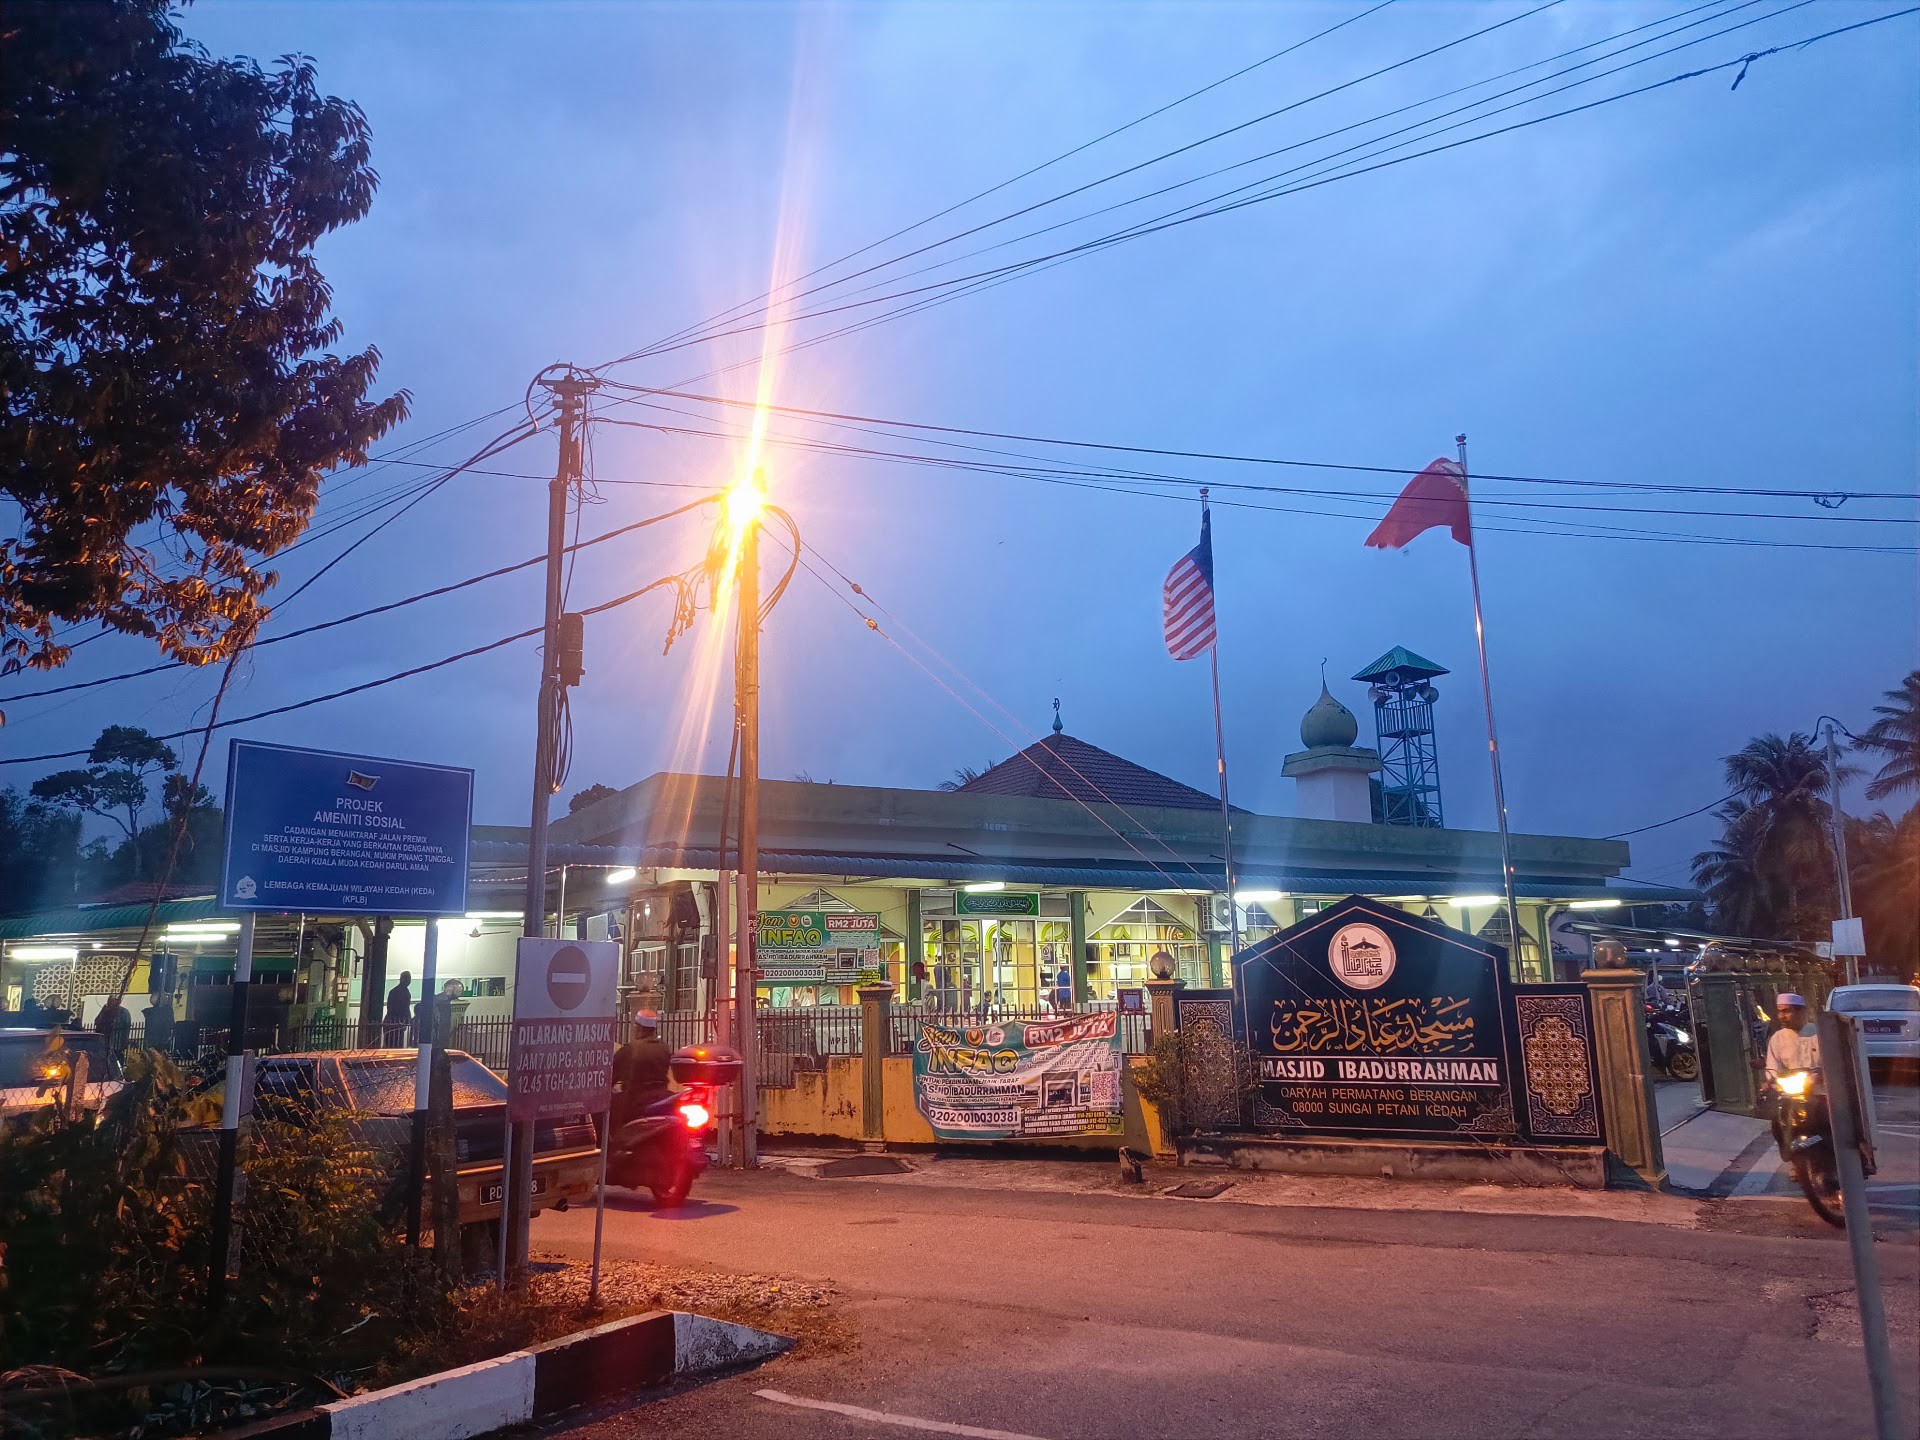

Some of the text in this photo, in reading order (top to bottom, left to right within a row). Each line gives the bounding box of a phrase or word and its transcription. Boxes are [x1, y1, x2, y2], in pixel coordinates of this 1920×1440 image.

[336, 797, 383, 813] PROJEK
[314, 811, 406, 829] AMENITI SOSIAL
[284, 825, 327, 836] CADANGAN
[328, 829, 378, 840] MENAIKTARAF
[379, 833, 401, 842] JALAN
[264, 834, 443, 853] SERTA KERJA-KERJA YANG BERKAITAN DENGANNYA
[261, 843, 290, 854] MASJID
[292, 846, 329, 856] KAMPUNG
[374, 851, 397, 860] MUKIM
[398, 853, 423, 862] PINANG
[424, 854, 455, 864] TUNGGAL
[278, 855, 310, 864] DAERAH
[311, 857, 337, 866] KUALA
[338, 859, 359, 867] MUDA
[360, 860, 385, 869] KEDAH
[385, 862, 409, 871] DARUL
[264, 880, 435, 896] LEMBAGA KEMAJUAN WILAYAH KEDAH (KEDA)
[342, 895, 368, 905] (KPLB)
[828, 919, 875, 929] RM2 JUTA
[760, 928, 822, 947] INFAQ
[765, 969, 824, 977] 02020010030381
[518, 1023, 611, 1046] DILARANG MASUK
[1028, 1020, 1110, 1044] RM2 JUTA
[517, 1052, 538, 1071] JAM
[928, 1048, 1019, 1075] INFAQ
[1262, 1060, 1498, 1081] MASJID IBADURRAHMAN
[519, 1074, 541, 1094] 12.45
[922, 1083, 1025, 1096] ASJID IBADURRAHMAN
[1280, 1087, 1477, 1102] QARYAH PERMATANG BERANGAN
[929, 1109, 1018, 1123] 02020010030381
[1292, 1102, 1467, 1117] 08000 SUNGAI PETANI KEDAH
